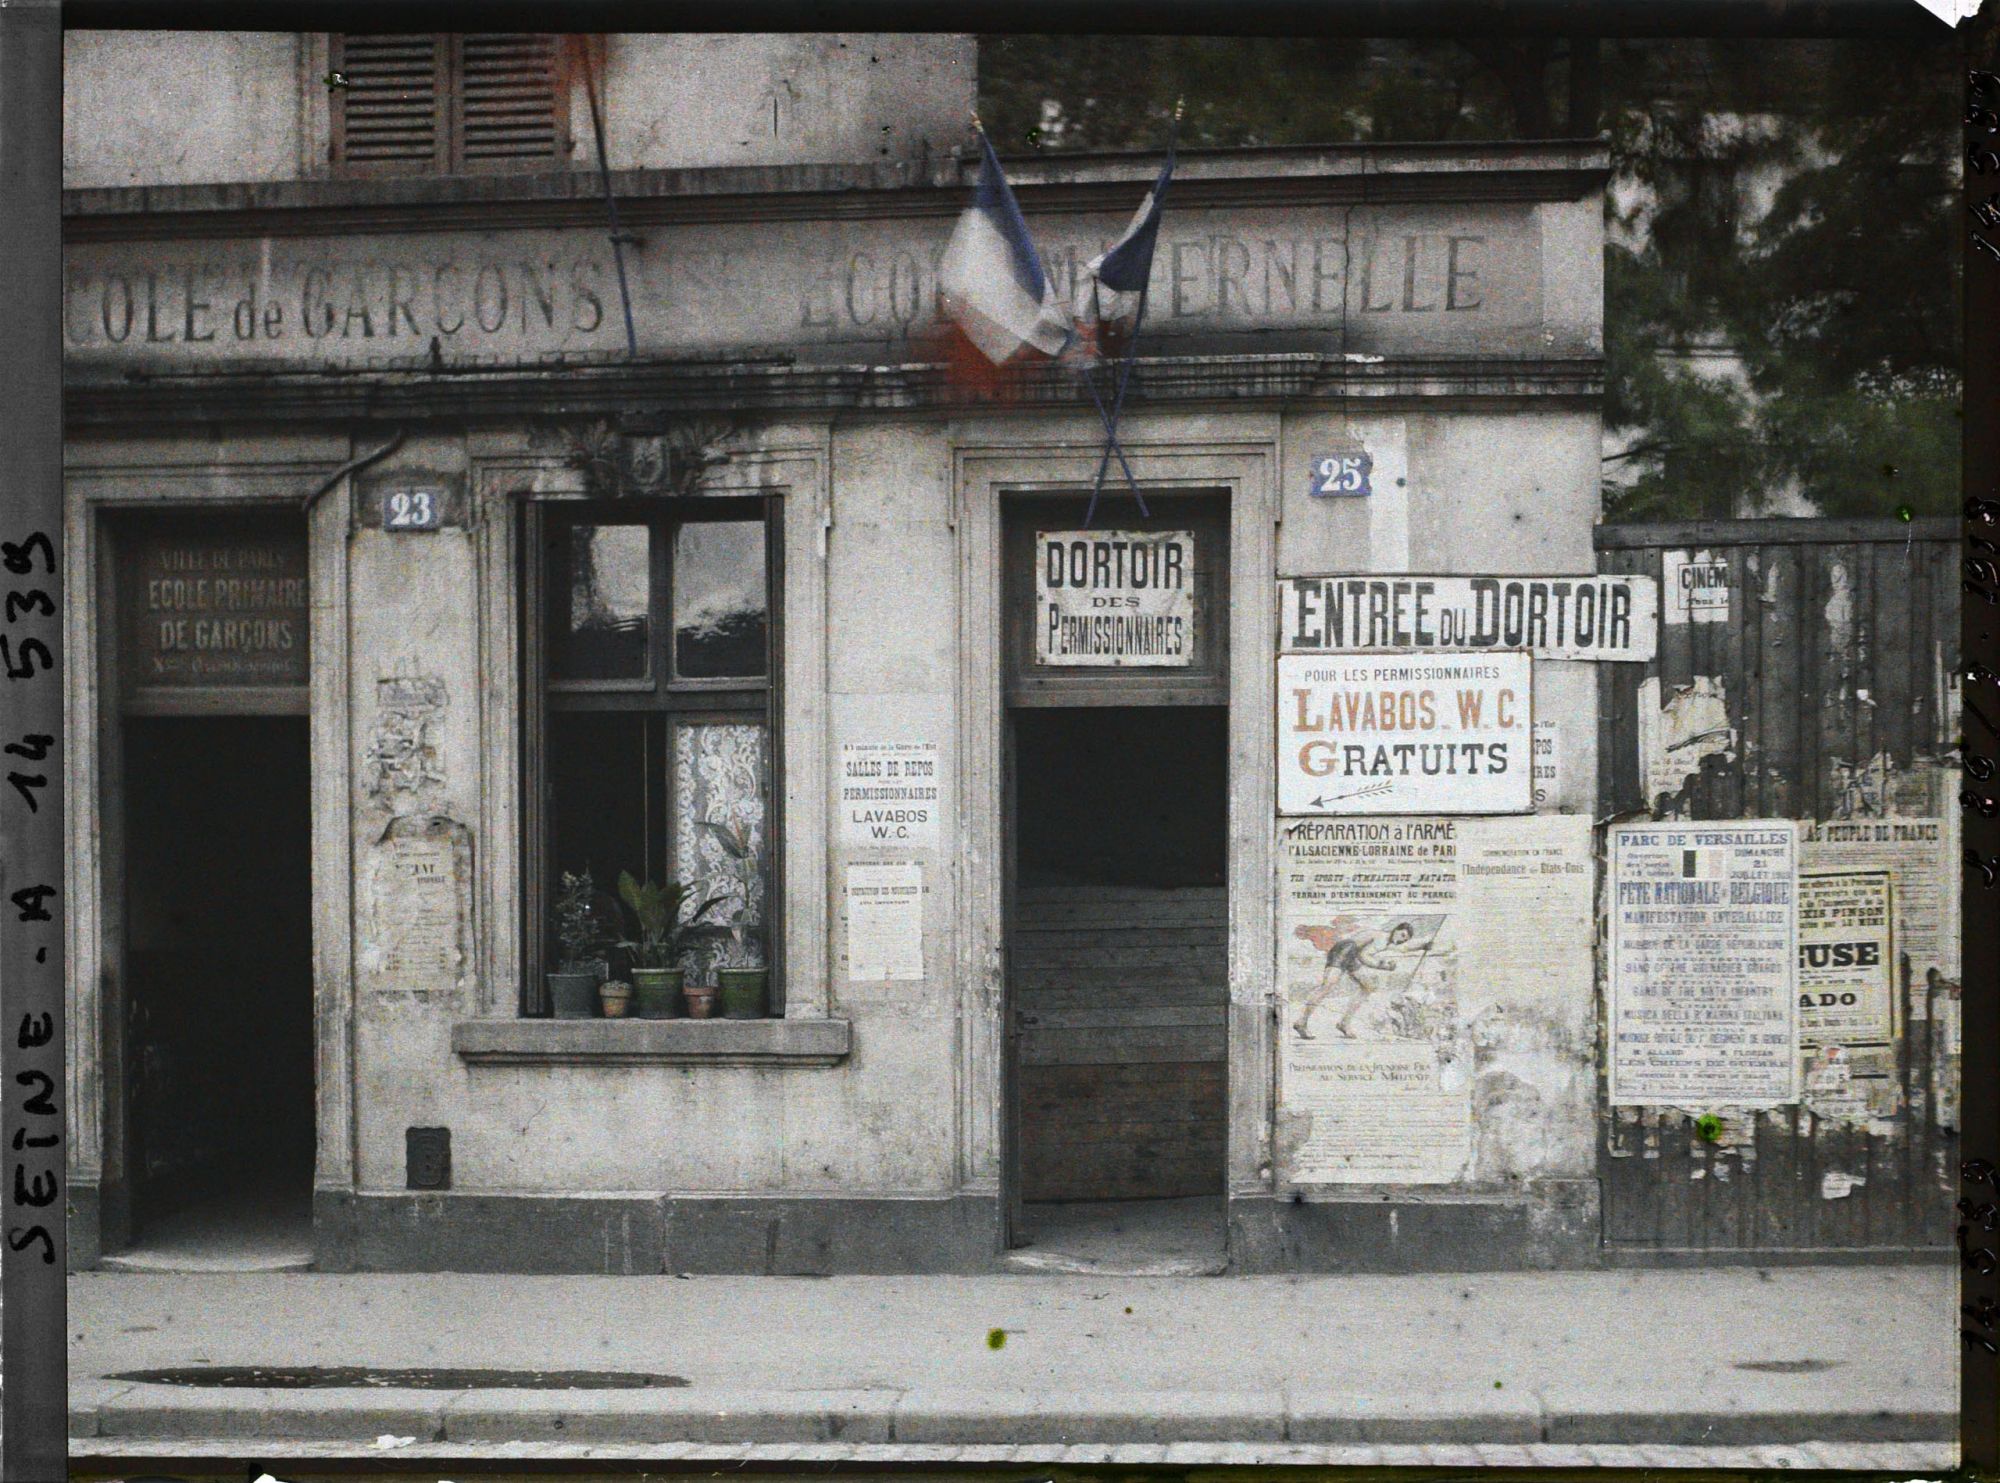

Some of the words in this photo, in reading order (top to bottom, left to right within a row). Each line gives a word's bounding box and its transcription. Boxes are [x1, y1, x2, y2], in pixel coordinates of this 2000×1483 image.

[233, 281, 284, 340] de
[1319, 458, 1363, 492] 25
[390, 492, 431, 526] 23
[1046, 541, 1183, 590] DORTOIR
[214, 578, 306, 610] PRIMAIRE
[1092, 596, 1141, 608] DES
[1292, 579, 1435, 648] ENTREE
[1440, 608, 1467, 647] DU
[1469, 578, 1632, 649] DORTOIR
[160, 620, 188, 650] DE
[195, 619, 293, 653] GARÇONS
[1048, 602, 1183, 655] PERMISSIONNAIRES
[1304, 670, 1337, 682] POUR
[1344, 669, 1369, 681] LES
[1374, 666, 1500, 681] PERMISSIONNAIRES
[845, 761, 882, 777] SALLES
[887, 761, 899, 777] DE
[905, 761, 934, 776] REPOS
[1297, 739, 1508, 777] GRATUITS
[5, 733, 56, 813] 14
[843, 787, 938, 801] PERMISSIONNAIRES
[852, 809, 928, 824] LAVABOS
[1394, 825, 1403, 840] à
[1620, 835, 1660, 846] PARC
[1667, 835, 1686, 846] DE
[1694, 833, 1788, 846] VERSAILLES
[1827, 825, 1870, 842] PEUPLE
[1875, 825, 1890, 841] DE
[1894, 824, 1939, 841] FRANCE
[1417, 845, 1429, 856] de
[1733, 848, 1785, 857] DIMANCHE
[11, 883, 56, 923] A
[1655, 881, 1721, 905] NATIONALE
[1729, 881, 1790, 904] BELGIQUE
[1624, 911, 1706, 924] MANIFESTATION
[1832, 907, 1884, 918] PINSON
[8, 1010, 57, 1265] SEINE
